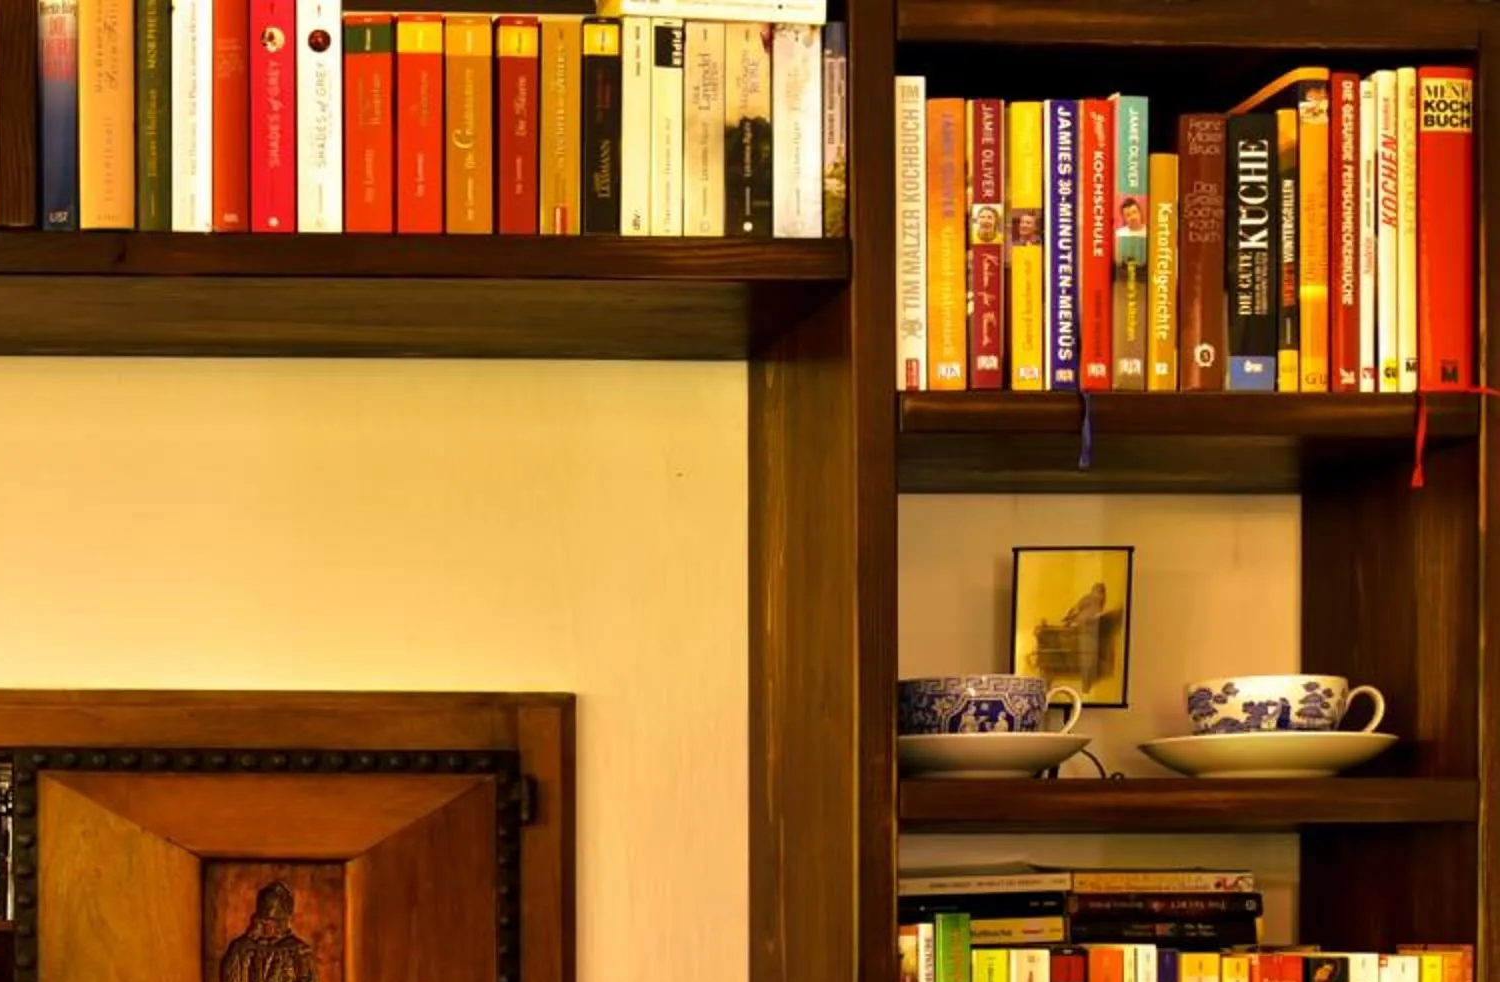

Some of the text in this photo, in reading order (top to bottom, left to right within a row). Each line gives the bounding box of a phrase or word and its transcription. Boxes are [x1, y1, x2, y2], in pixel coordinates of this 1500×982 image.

[267, 60, 281, 99] GREY
[269, 98, 284, 112] of
[314, 61, 327, 97] GREY
[315, 99, 329, 113] of
[697, 52, 710, 111] Lavendel
[1423, 100, 1471, 113] KOCH
[268, 113, 282, 169] SHADES
[314, 115, 327, 169] SHADES
[981, 103, 995, 199] JAMIE OLIVER
[1127, 107, 1140, 188] JAMIE OLIVER
[1341, 80, 1356, 161] DIE GESUNDE
[1423, 114, 1471, 129] BUCH
[901, 108, 921, 312] TIM KOCHBUCH
[1092, 150, 1105, 258] KOCHSCHULE
[1380, 132, 1398, 230] KOCHEN
[1057, 105, 1073, 361] JAMIES 30-MINUTEN-MENÜS
[1283, 179, 1296, 263] WINTERGRILLEN
[1152, 202, 1172, 341] Kartoffelgerichte
[1237, 252, 1253, 316] DIE GUTE
